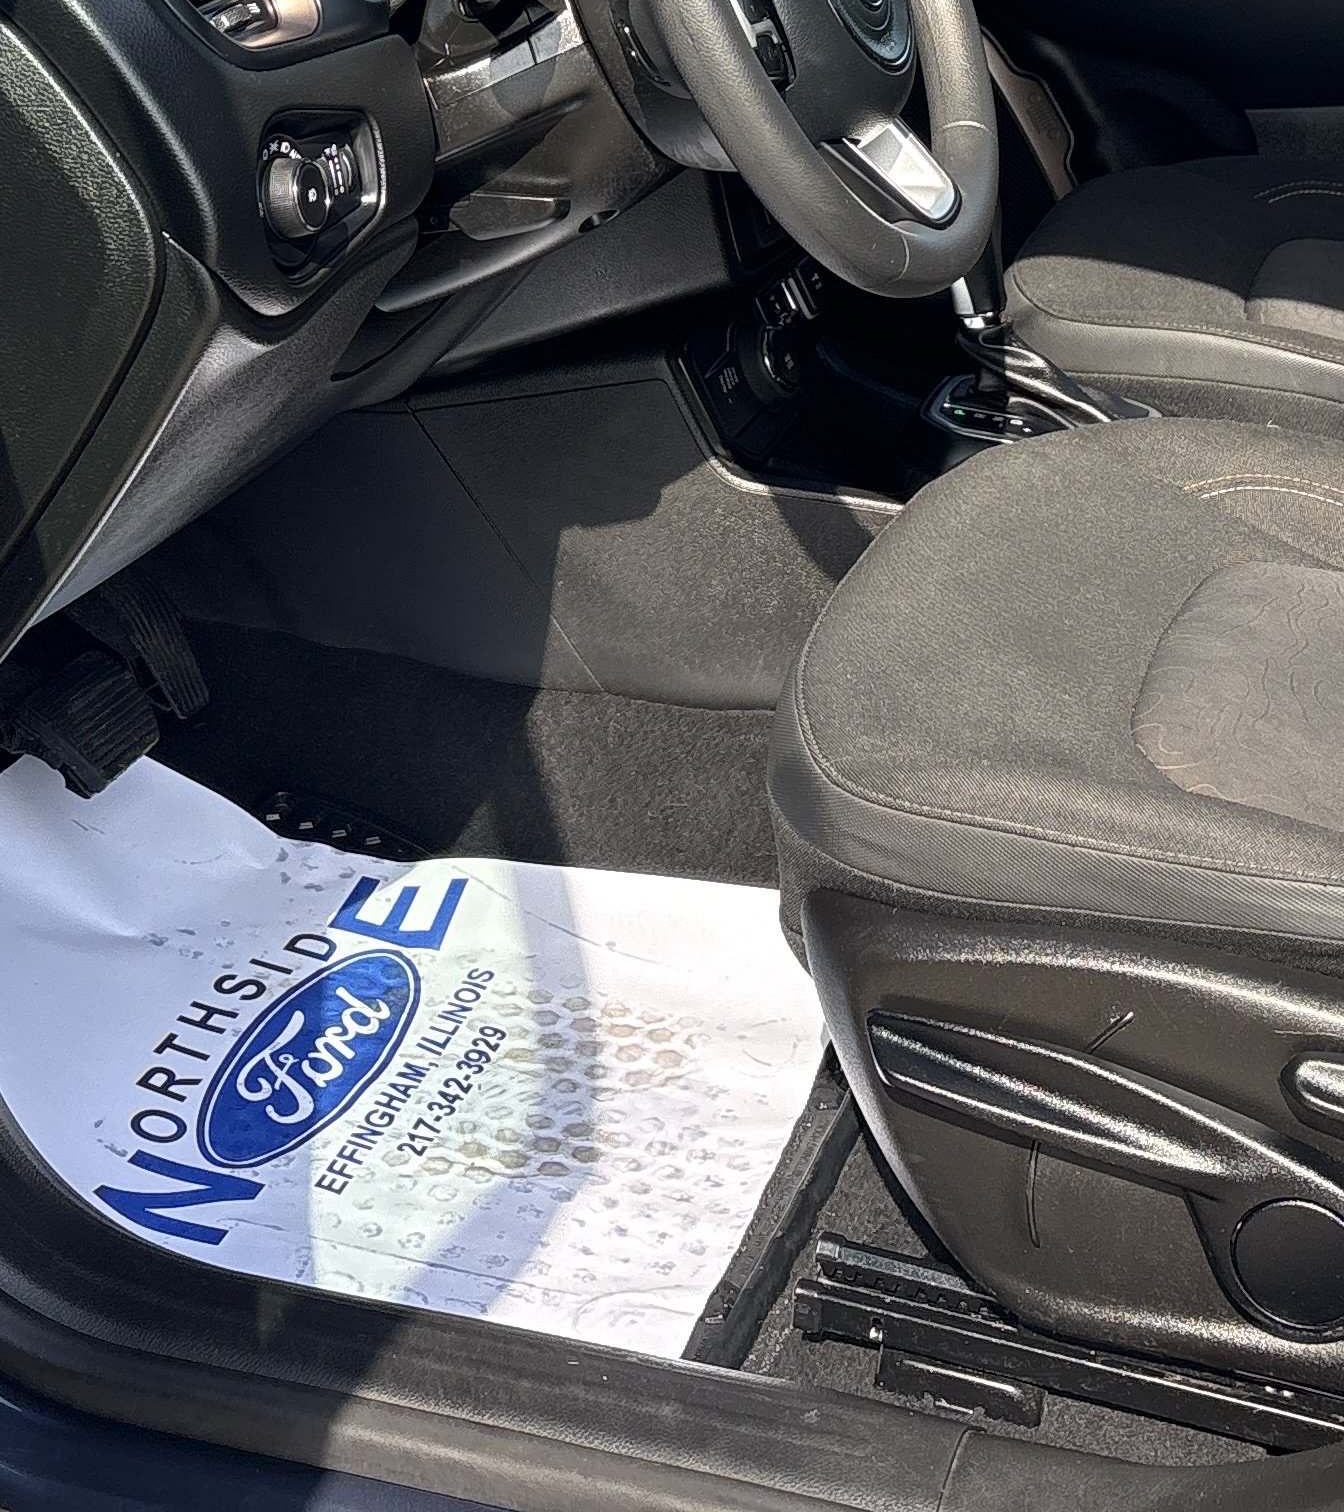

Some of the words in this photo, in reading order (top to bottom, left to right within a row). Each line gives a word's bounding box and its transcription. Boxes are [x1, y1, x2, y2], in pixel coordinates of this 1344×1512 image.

[93, 876, 469, 1246] NORTHSIDE
[236, 986, 391, 1125] Ford
[314, 1061, 440, 1196] EFFINGHAM,
[415, 967, 495, 1056] ILLINOIS
[396, 1025, 507, 1157] 217-342-3929
